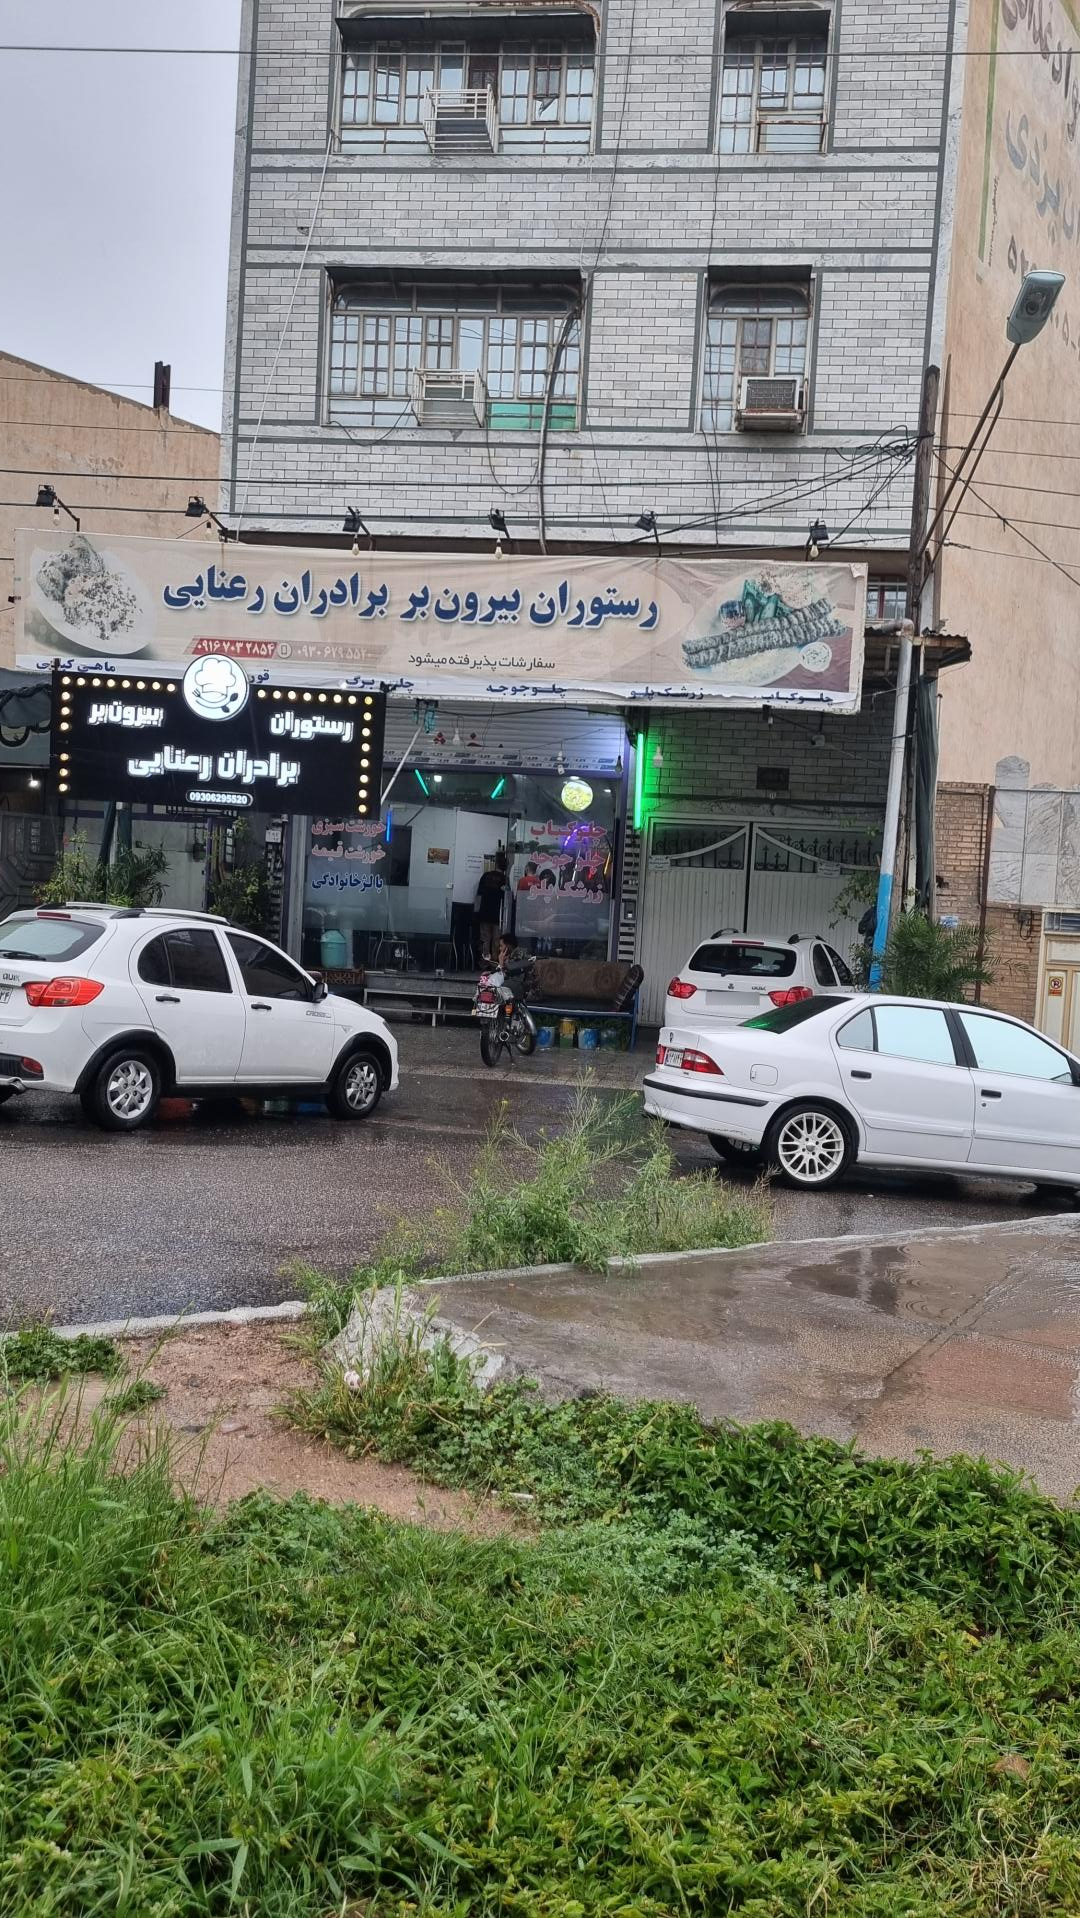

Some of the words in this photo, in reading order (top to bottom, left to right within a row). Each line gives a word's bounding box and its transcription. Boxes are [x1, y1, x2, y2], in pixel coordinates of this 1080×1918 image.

[162, 563, 266, 613] رعنایی
[273, 568, 390, 618] برادران
[528, 579, 662, 629] رستوران
[77, 661, 116, 674] ماهی
[407, 652, 448, 668] میشود
[448, 654, 497, 672] پذیرفته
[498, 656, 556, 672] سفارشات
[270, 711, 354, 743] رستوران
[127, 744, 213, 782] رعنایی
[216, 749, 301, 787] برادران
[189, 791, 248, 805] 09306295520
[311, 818, 345, 836] سبزی
[311, 840, 344, 862] قیمه
